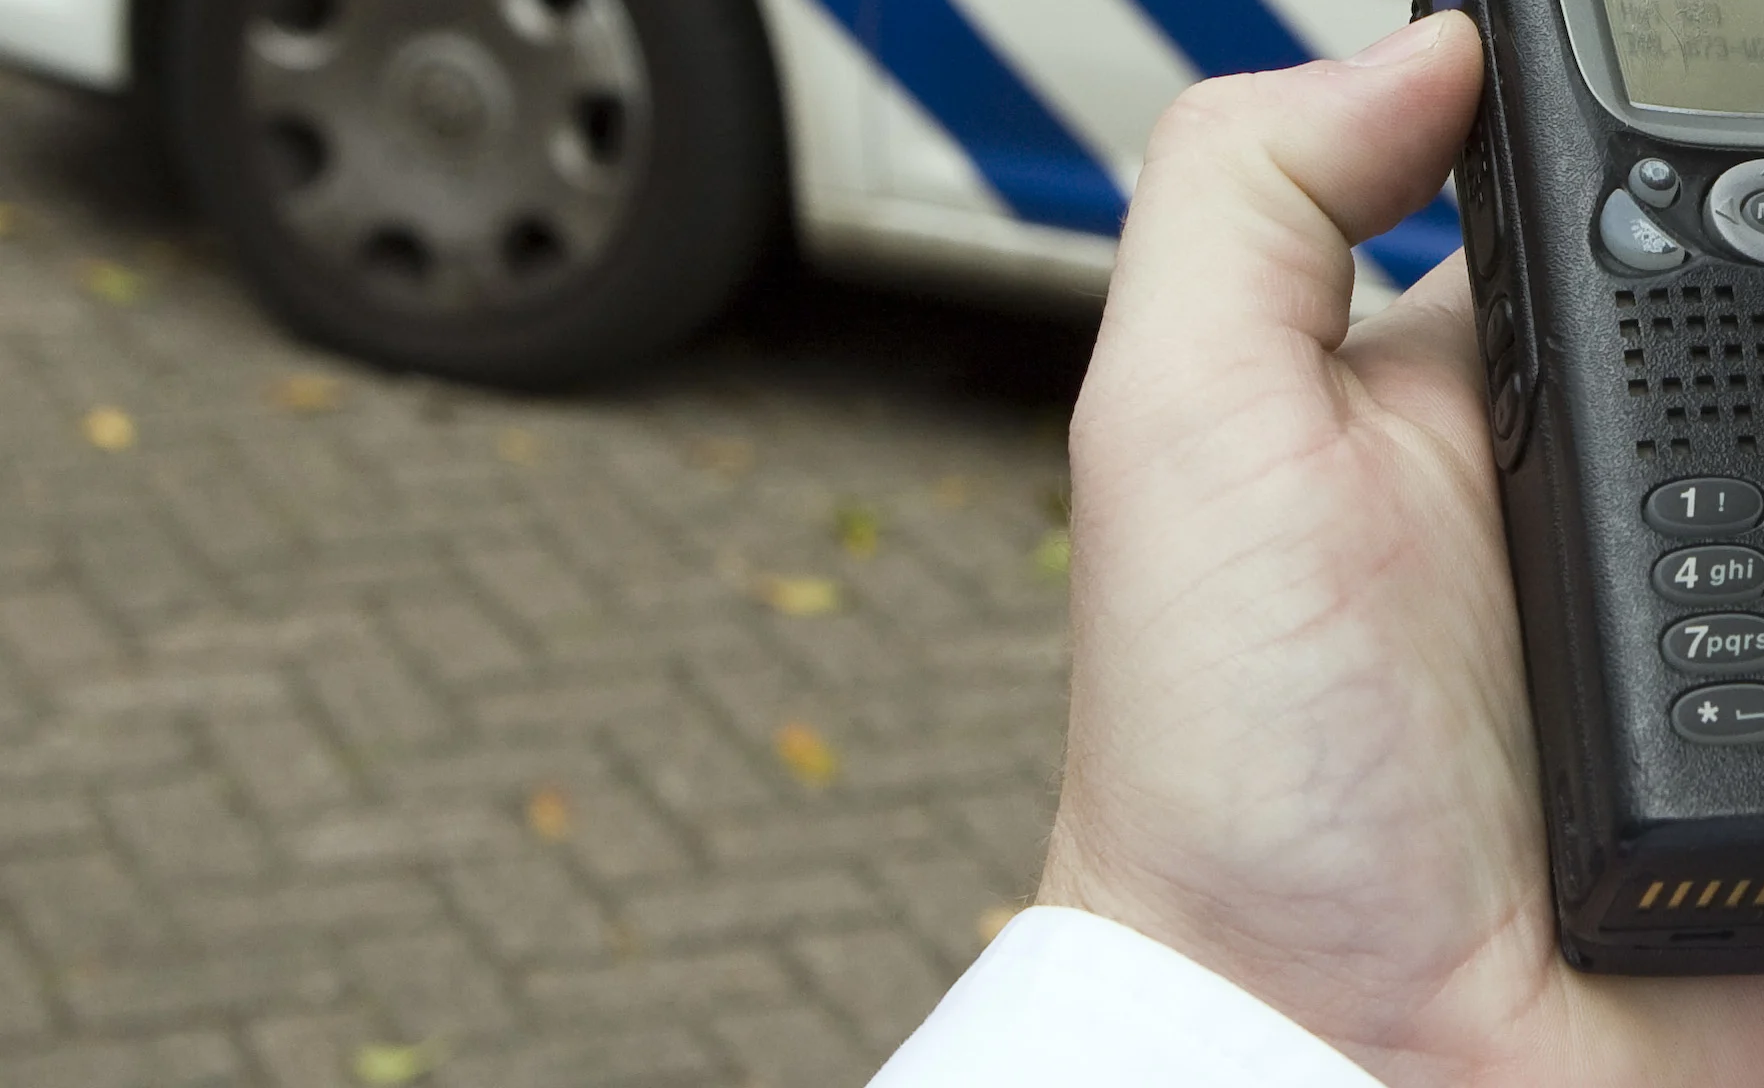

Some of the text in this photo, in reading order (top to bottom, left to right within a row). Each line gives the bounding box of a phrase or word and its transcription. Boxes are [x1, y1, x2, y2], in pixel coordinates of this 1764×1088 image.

[1680, 487, 1696, 518] 1
[1674, 556, 1754, 589] 4 ghi
